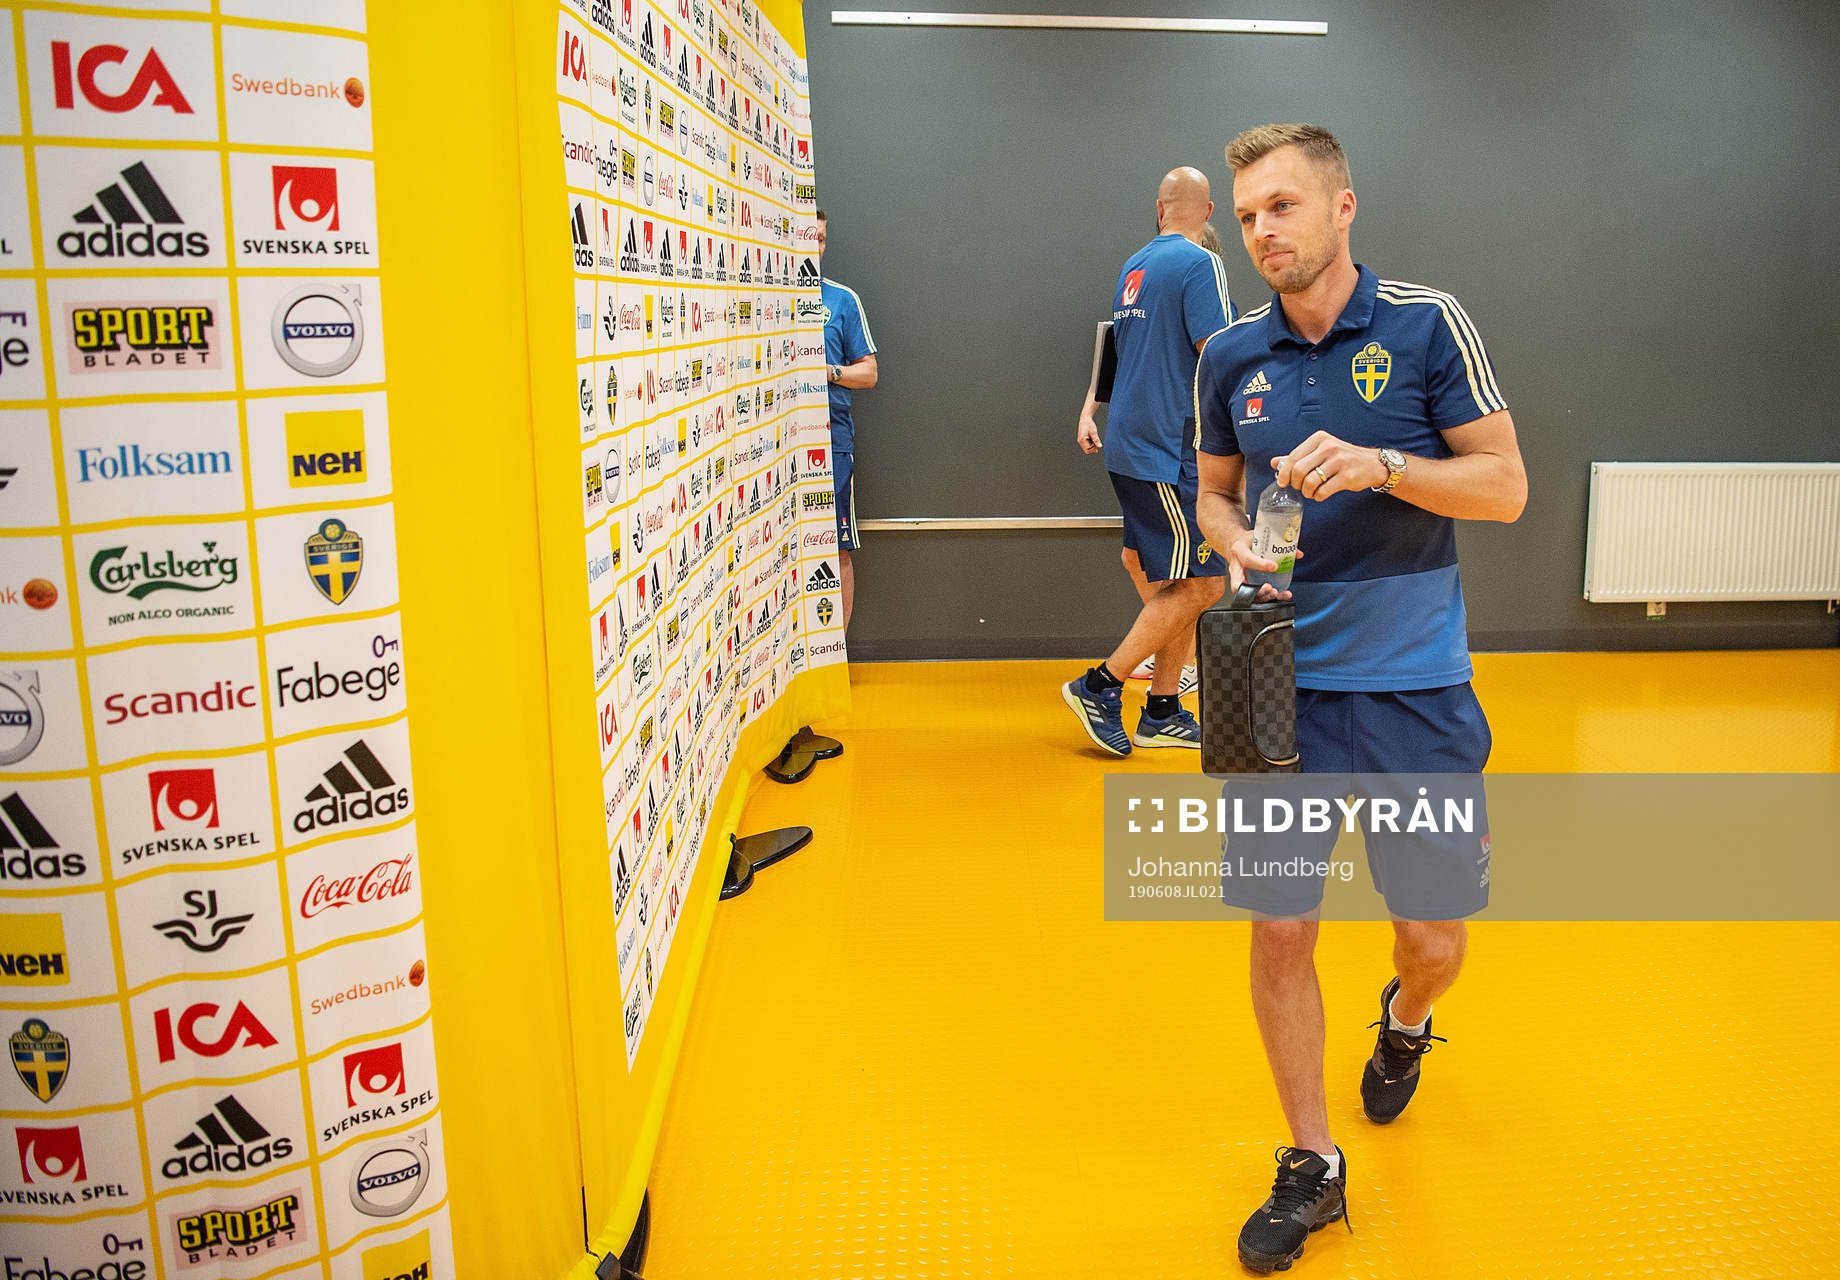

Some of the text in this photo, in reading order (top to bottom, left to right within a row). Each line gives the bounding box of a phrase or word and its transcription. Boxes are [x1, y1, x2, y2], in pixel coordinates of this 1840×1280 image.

[563, 30, 588, 87] ICA
[51, 40, 195, 114] ICA
[231, 73, 341, 100] Swedbank
[57, 222, 210, 258] adidas
[243, 239, 370, 255] SVENSKA SPEL
[72, 306, 214, 353] SPORT
[286, 325, 353, 337] VOLVO
[83, 351, 211, 368] BLADET
[1243, 383, 1272, 396] adidas
[1239, 418, 1258, 426] SVENSKA
[75, 444, 233, 483] Folksam
[804, 530, 836, 547] Coca-Cola
[89, 543, 238, 596] Carlsberg
[806, 579, 840, 592] adidas
[108, 605, 235, 626] NON ALCO ORGANIC
[809, 641, 845, 657] Scandic
[104, 680, 257, 725] Scandic
[276, 661, 400, 708] Fabege
[293, 787, 410, 833] adidas
[0, 849, 87, 880] idas
[122, 833, 261, 865] SVENSKA SPEL
[300, 853, 413, 919] Coca-Cola
[183, 890, 218, 919] SJ
[311, 975, 406, 1015] Swedbank
[153, 1000, 280, 1064] ICA
[323, 1090, 434, 1142] SVENSKA SPEL
[161, 1137, 293, 1180] adidas
[81, 1184, 129, 1199] SPEL
[359, 1167, 420, 1190] VOLVO
[177, 1195, 299, 1254] SPORT
[188, 1229, 298, 1265] BLADET
